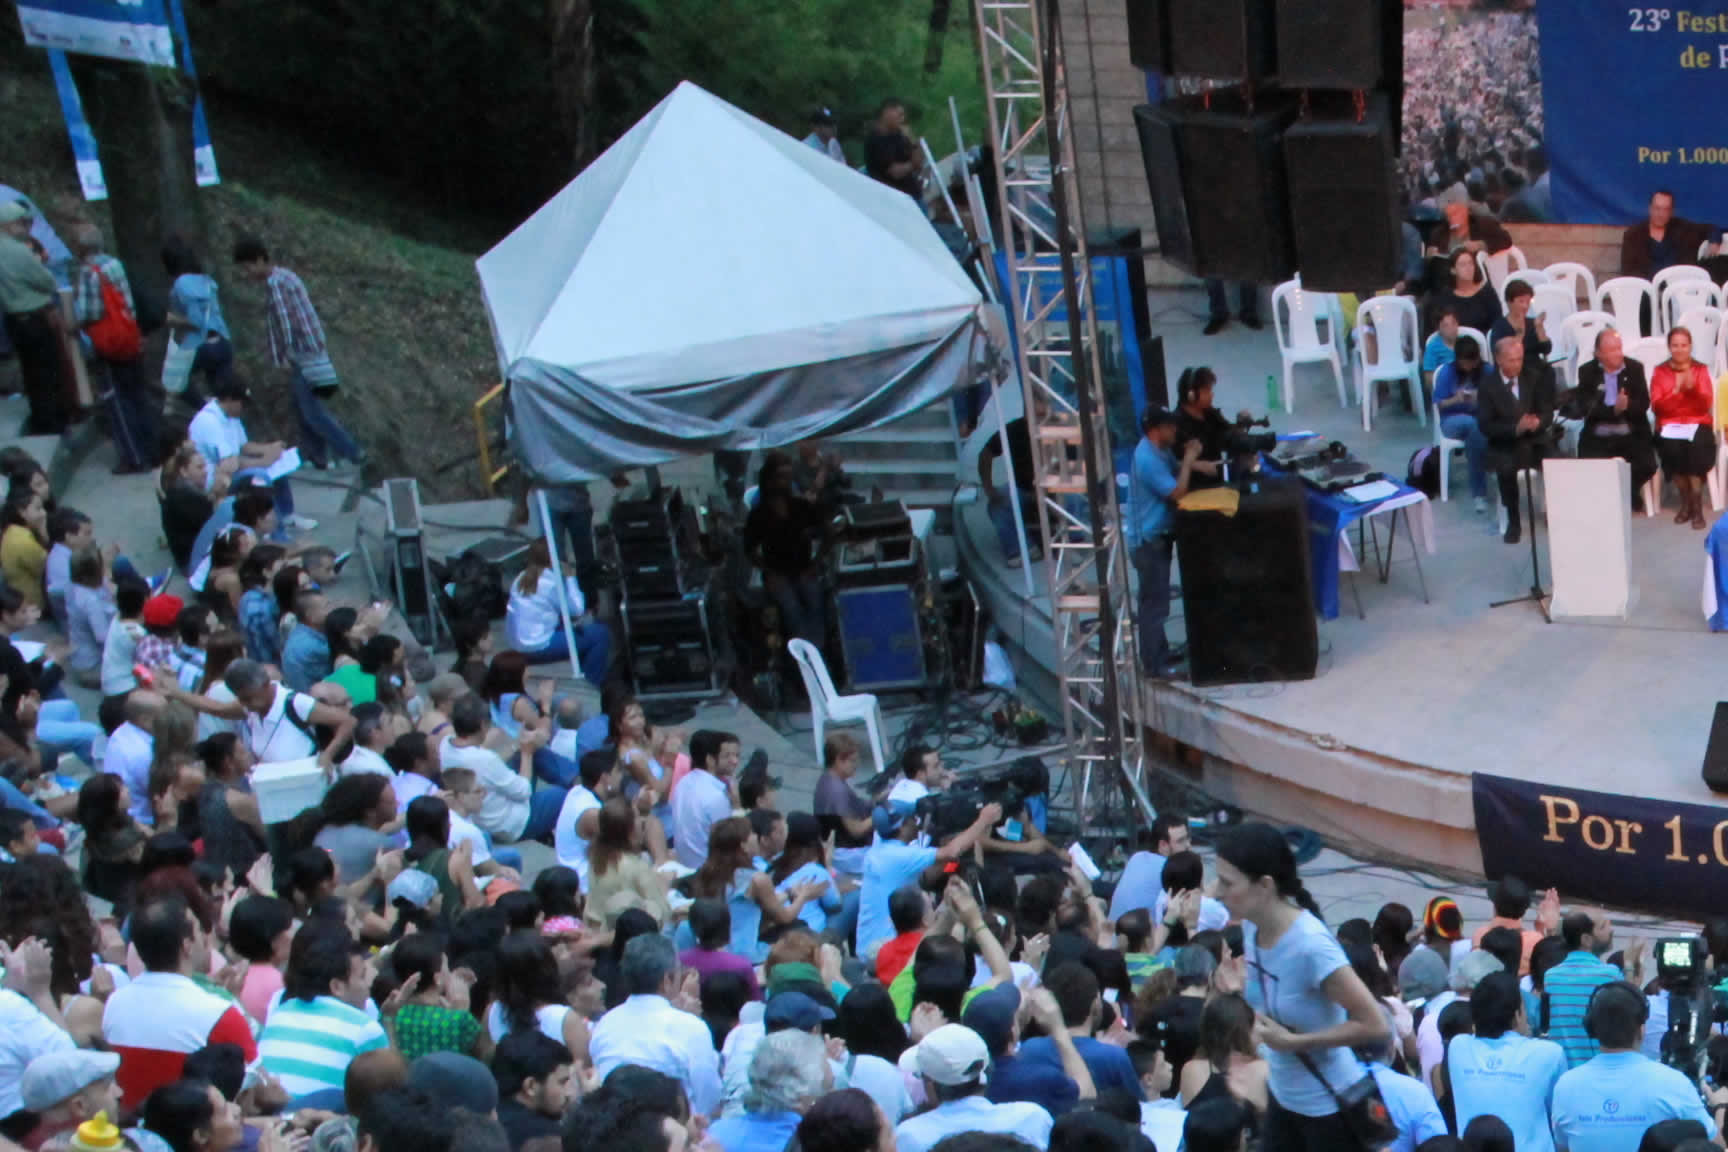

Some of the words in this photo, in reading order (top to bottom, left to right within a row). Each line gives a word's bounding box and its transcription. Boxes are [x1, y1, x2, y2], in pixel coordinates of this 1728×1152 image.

[1680, 45, 1711, 69] de
[1638, 146, 1672, 164] Por
[1540, 795, 1642, 855] Por
